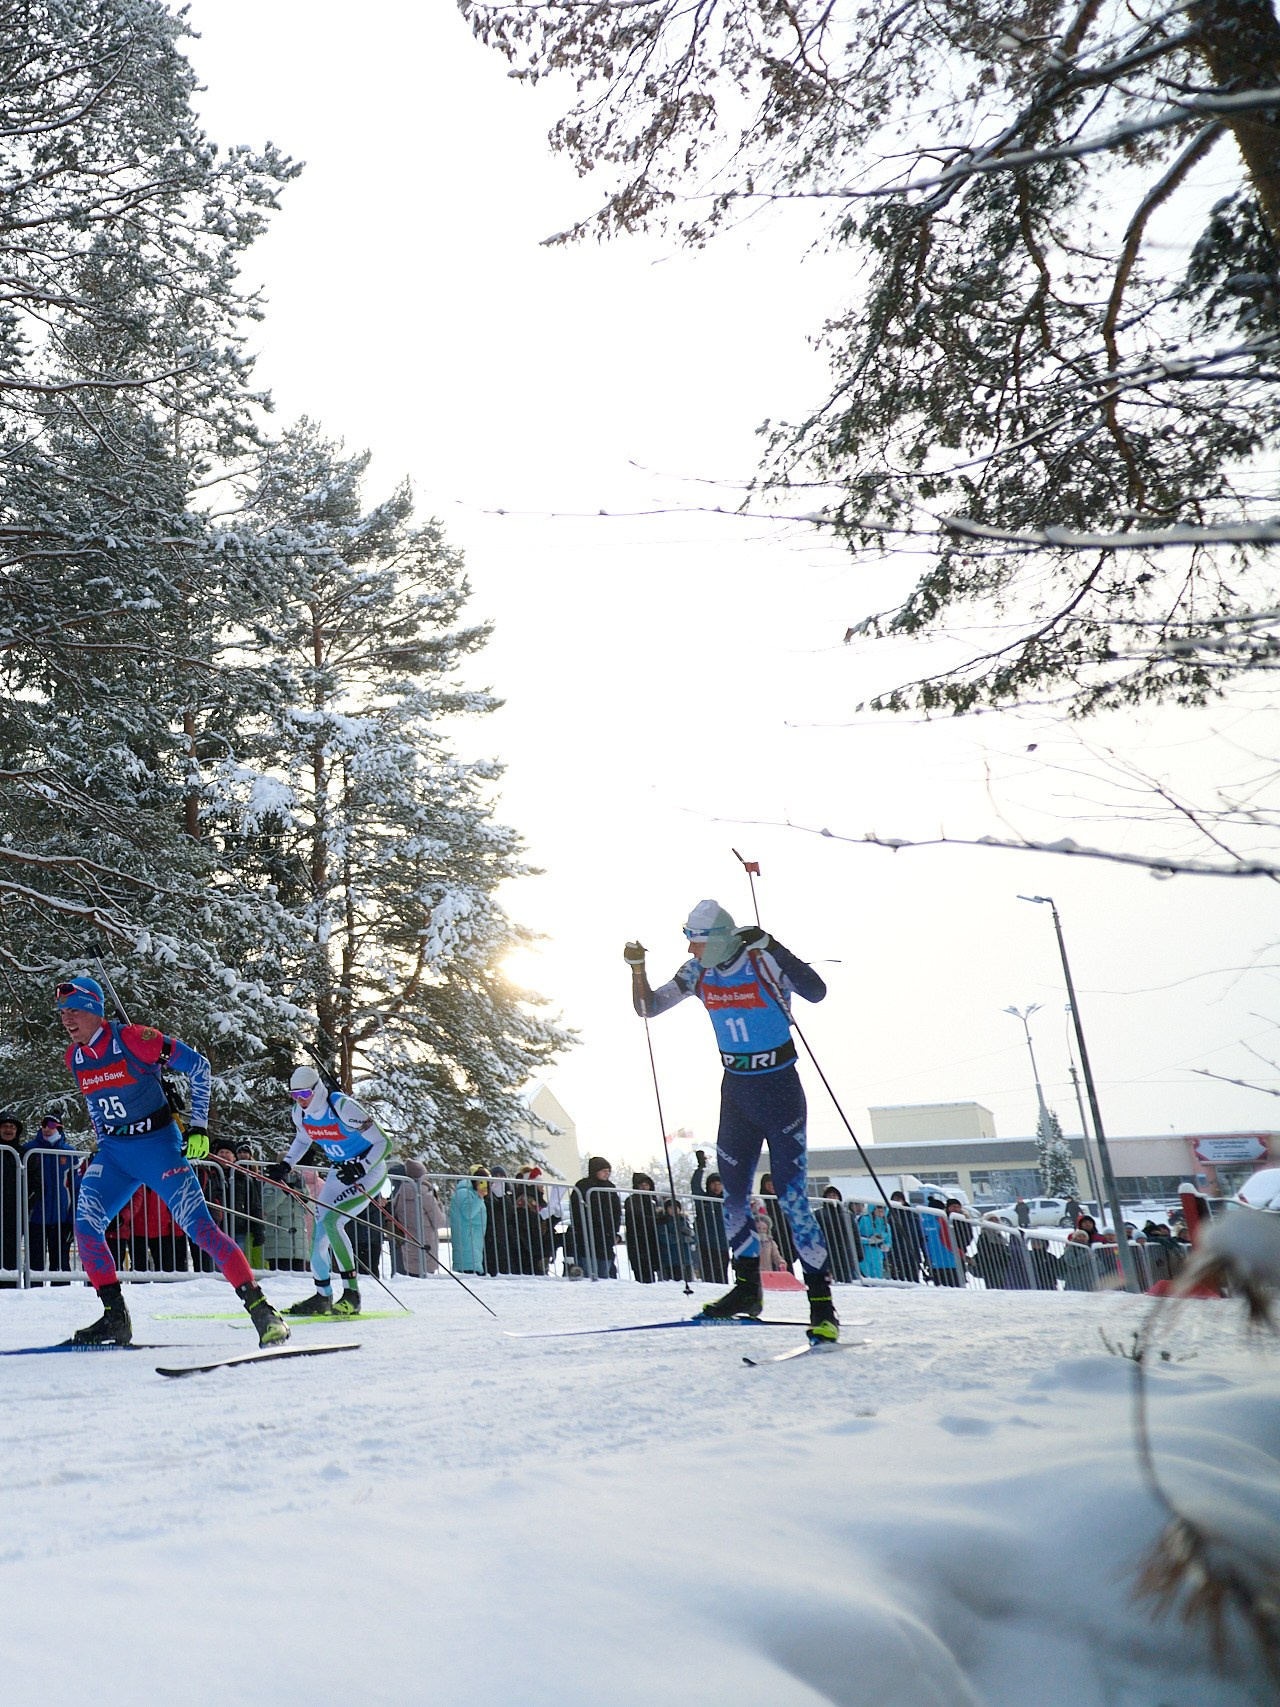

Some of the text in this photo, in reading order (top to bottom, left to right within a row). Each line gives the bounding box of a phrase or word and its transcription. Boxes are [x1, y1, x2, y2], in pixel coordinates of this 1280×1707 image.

[708, 991, 756, 1004] Альфа Банк
[725, 1017, 750, 1042] 11
[723, 1051, 777, 1069] PARI
[82, 1070, 125, 1088] Альфа Банк
[98, 1095, 127, 1119] 25
[104, 1117, 152, 1135] PARI
[323, 1144, 346, 1157] 40
